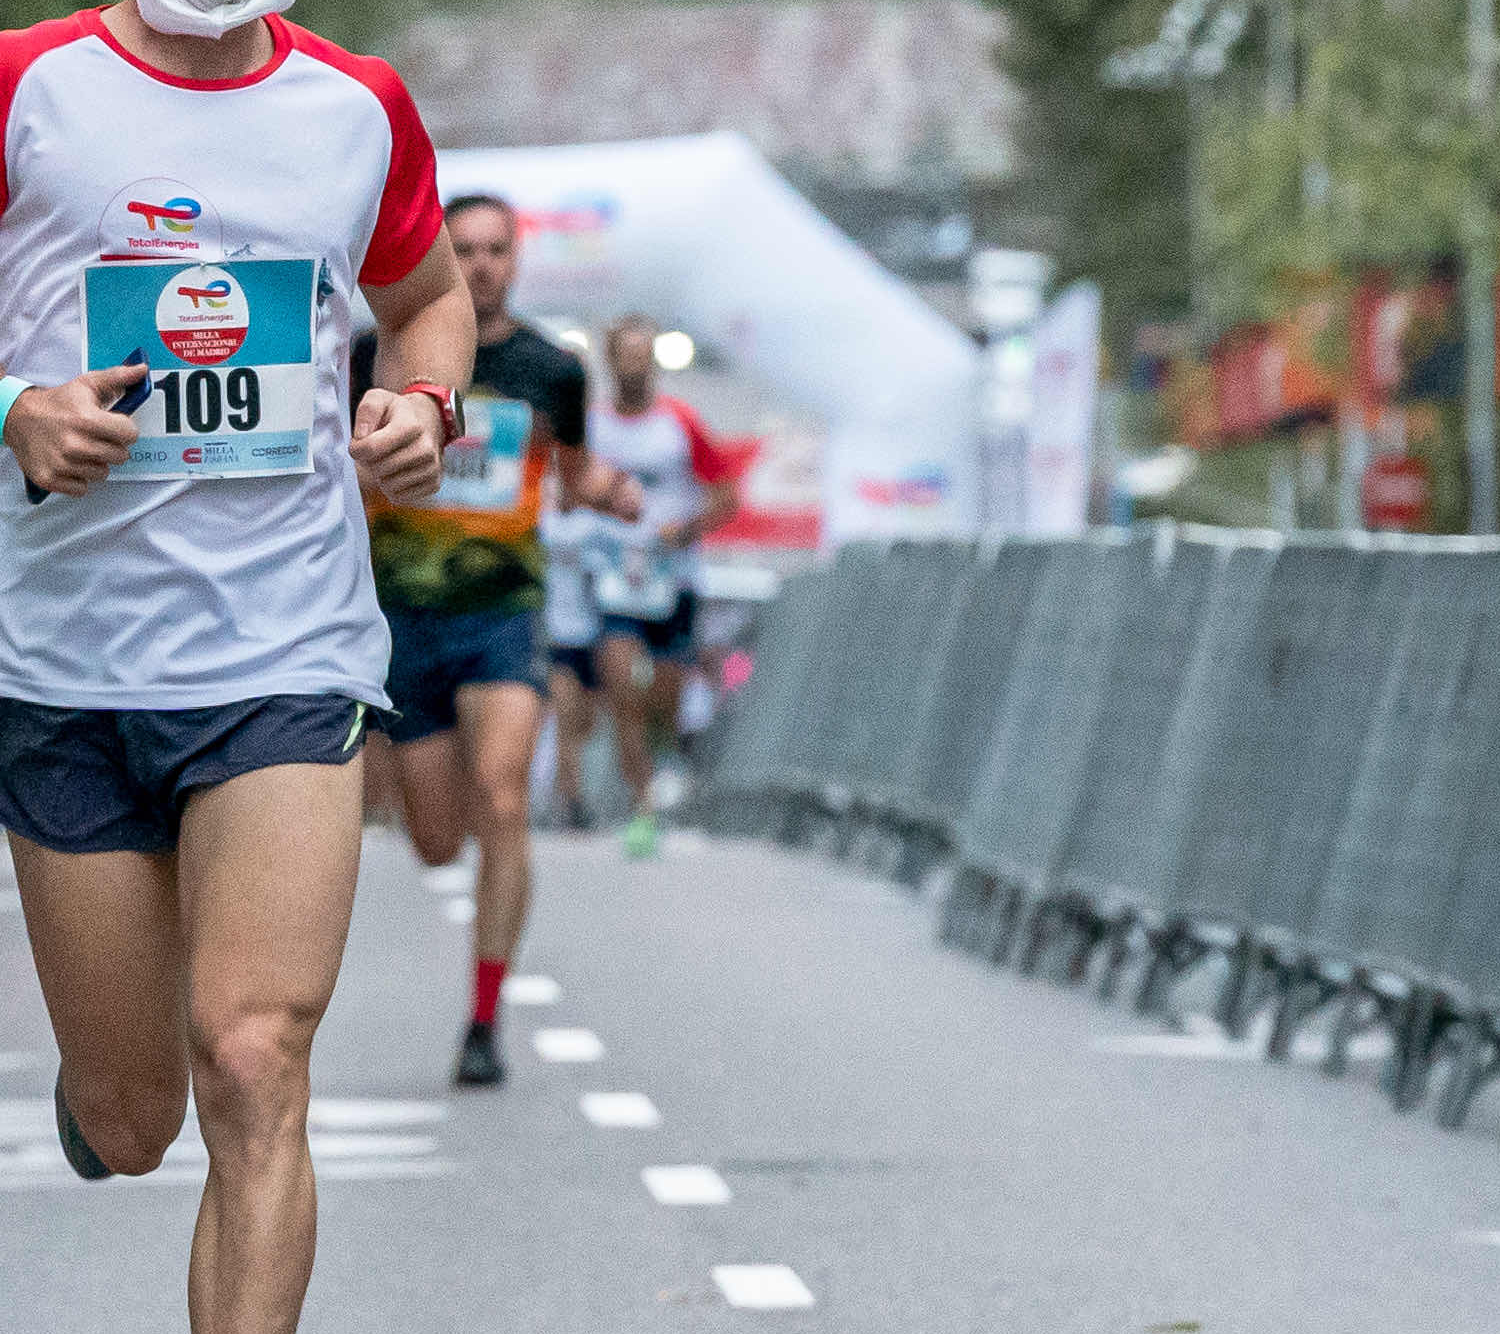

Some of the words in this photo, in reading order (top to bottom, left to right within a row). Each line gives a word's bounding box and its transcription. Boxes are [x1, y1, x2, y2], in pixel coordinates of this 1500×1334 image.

[127, 237, 200, 251] TotalEnergies
[192, 331, 220, 339] MILLA
[153, 367, 261, 434] 109
[129, 450, 168, 463] DRID
